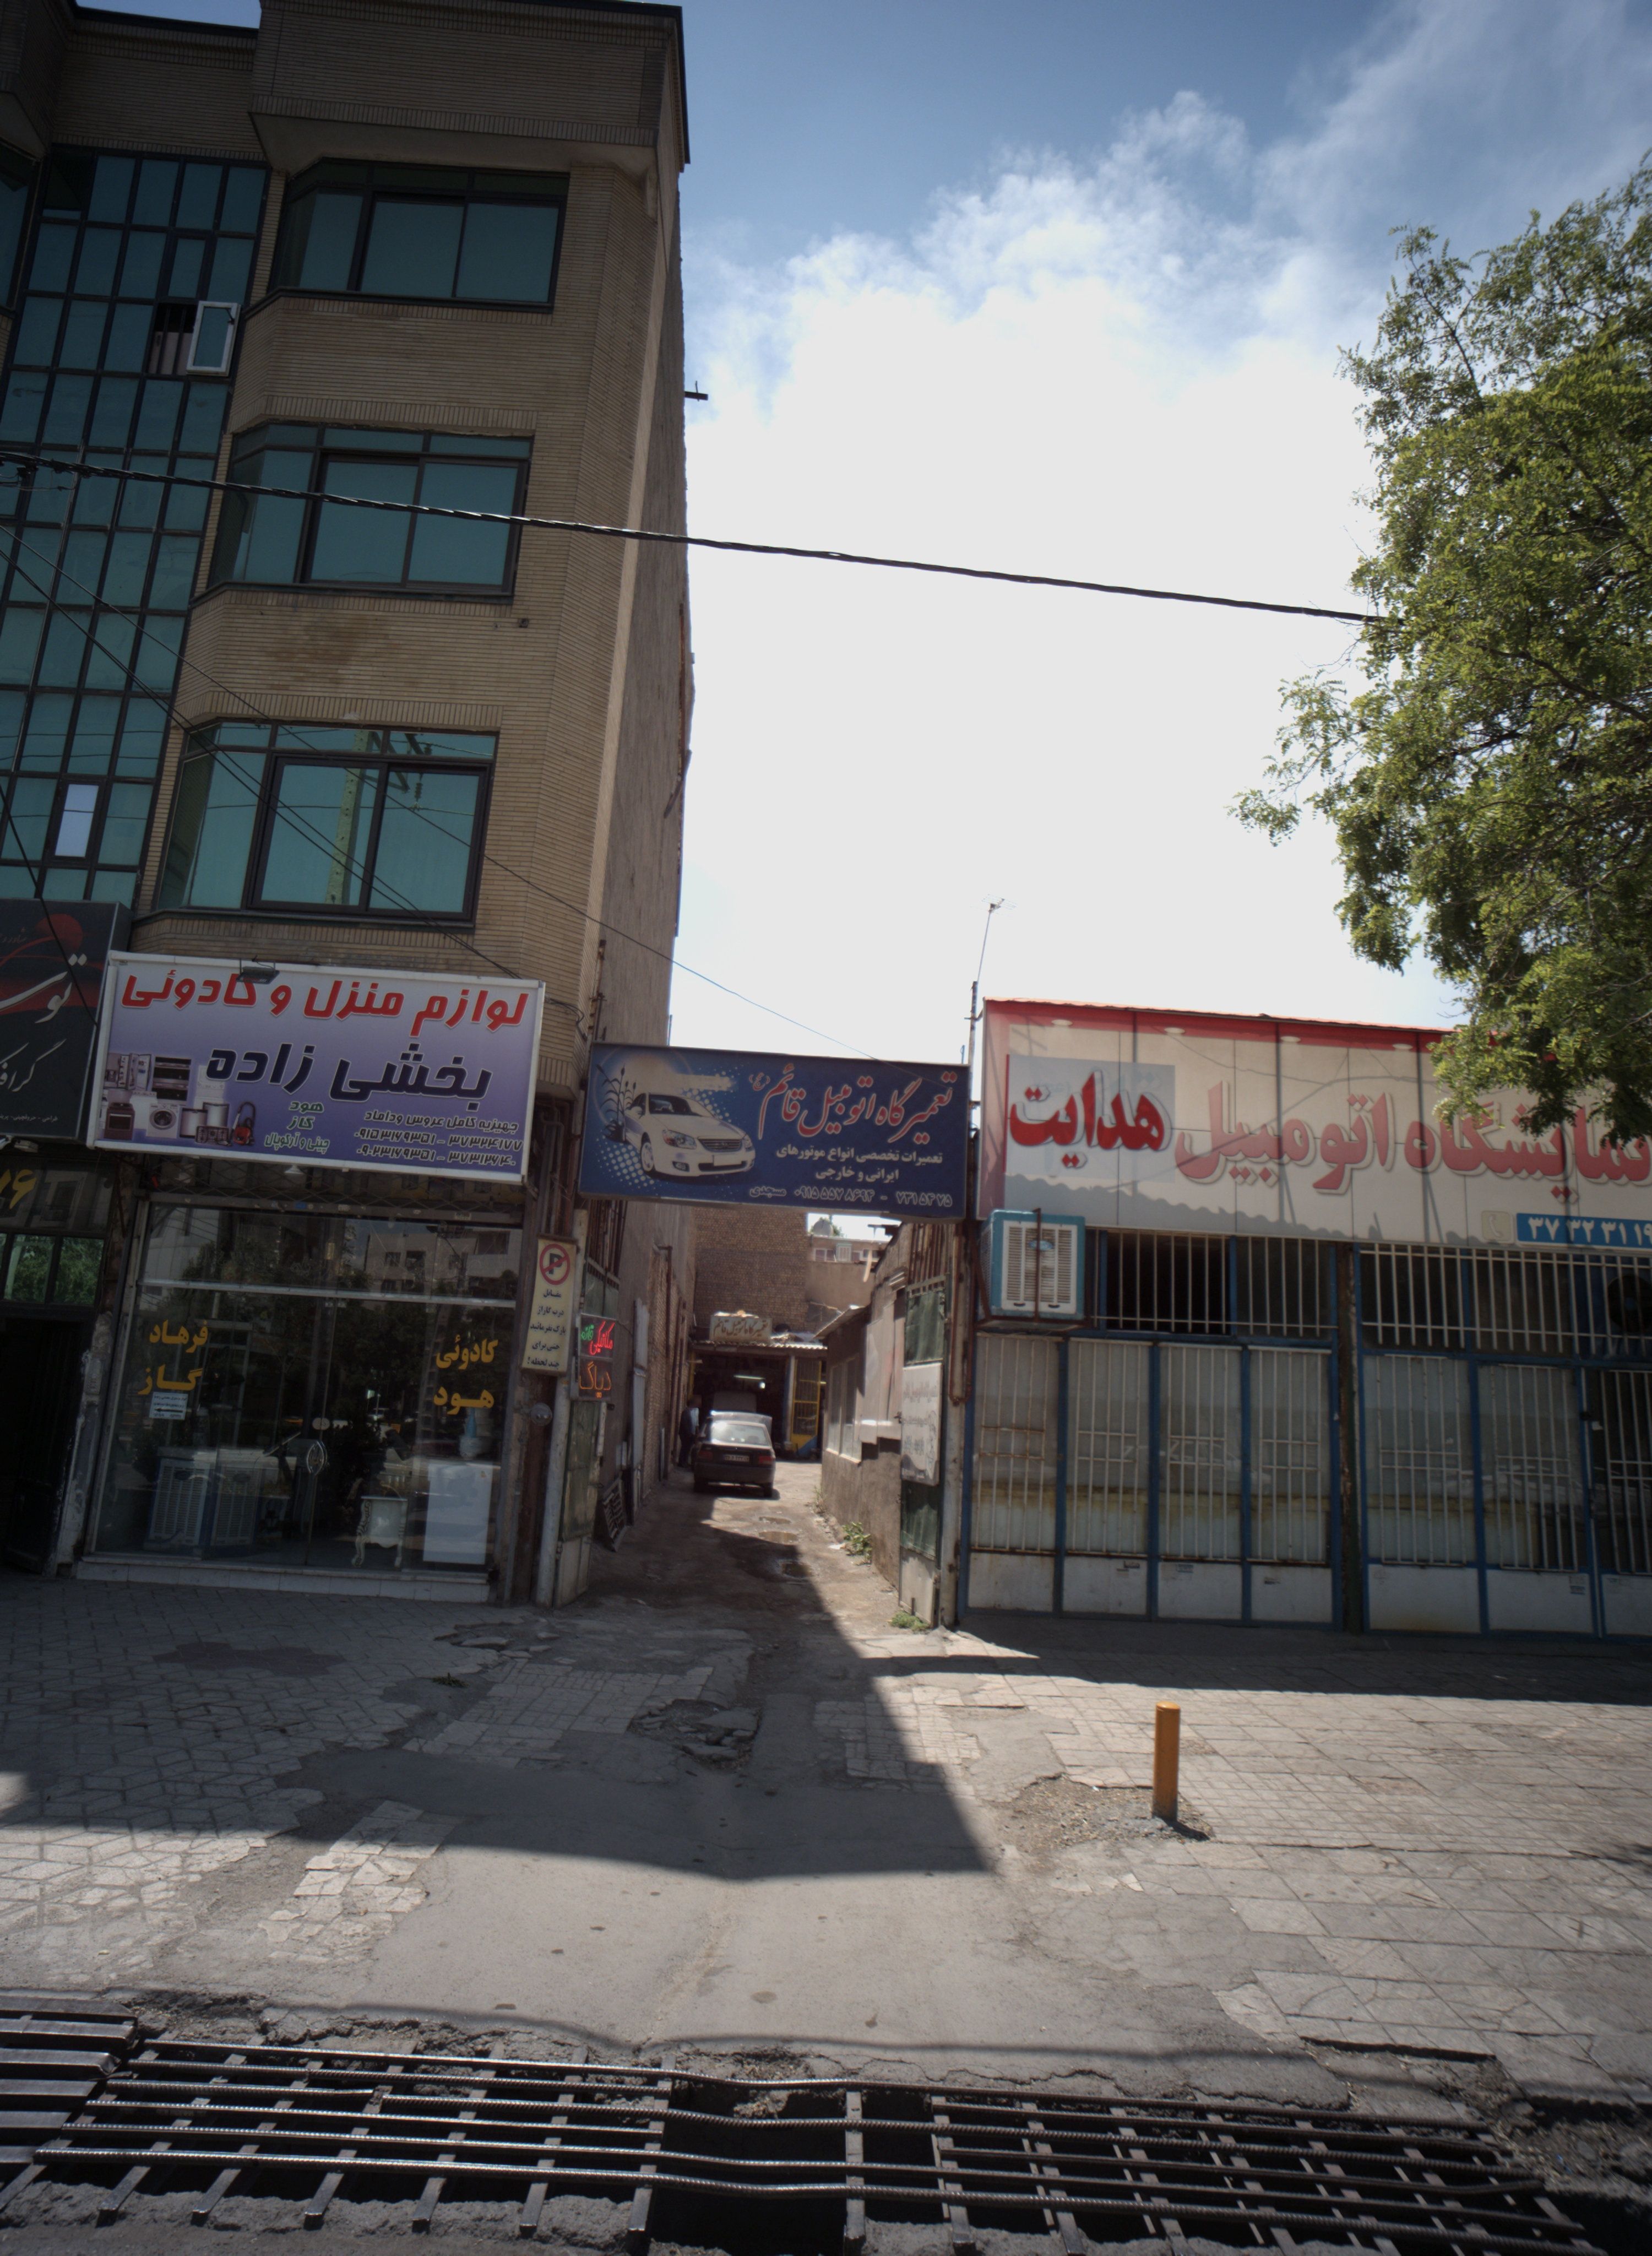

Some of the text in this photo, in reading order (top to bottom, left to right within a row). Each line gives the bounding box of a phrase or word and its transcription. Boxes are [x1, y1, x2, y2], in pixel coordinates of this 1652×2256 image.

[270, 985, 292, 1017] و
[304, 980, 405, 1021] منزل
[410, 988, 529, 1037] لوازم
[0, 1039, 67, 1093] گراف
[206, 1043, 493, 1111] بخشی زاده
[289, 1101, 324, 1114] هود
[758, 1063, 807, 1140] قائم
[875, 1072, 958, 1145] تعمیرگاه
[406, 1114, 445, 1127] عروس
[446, 1115, 477, 1129] کامل
[479, 1120, 519, 1135] جهیزیه
[1009, 1071, 1167, 1168] هدایت
[264, 1132, 330, 1154] چینی و آرکوپال
[1175, 1080, 1392, 1192] اتومبیل
[827, 1147, 855, 1162] انواع
[856, 1149, 900, 1163] تخصصی
[900, 1152, 943, 1166] تعمیرات
[815, 1166, 900, 1184] ایرانی و خارجی
[149, 1319, 208, 1353] فرهاد
[436, 1333, 499, 1370] کادوئی
[138, 1363, 203, 1395] گاز
[433, 1386, 494, 1416] هود
